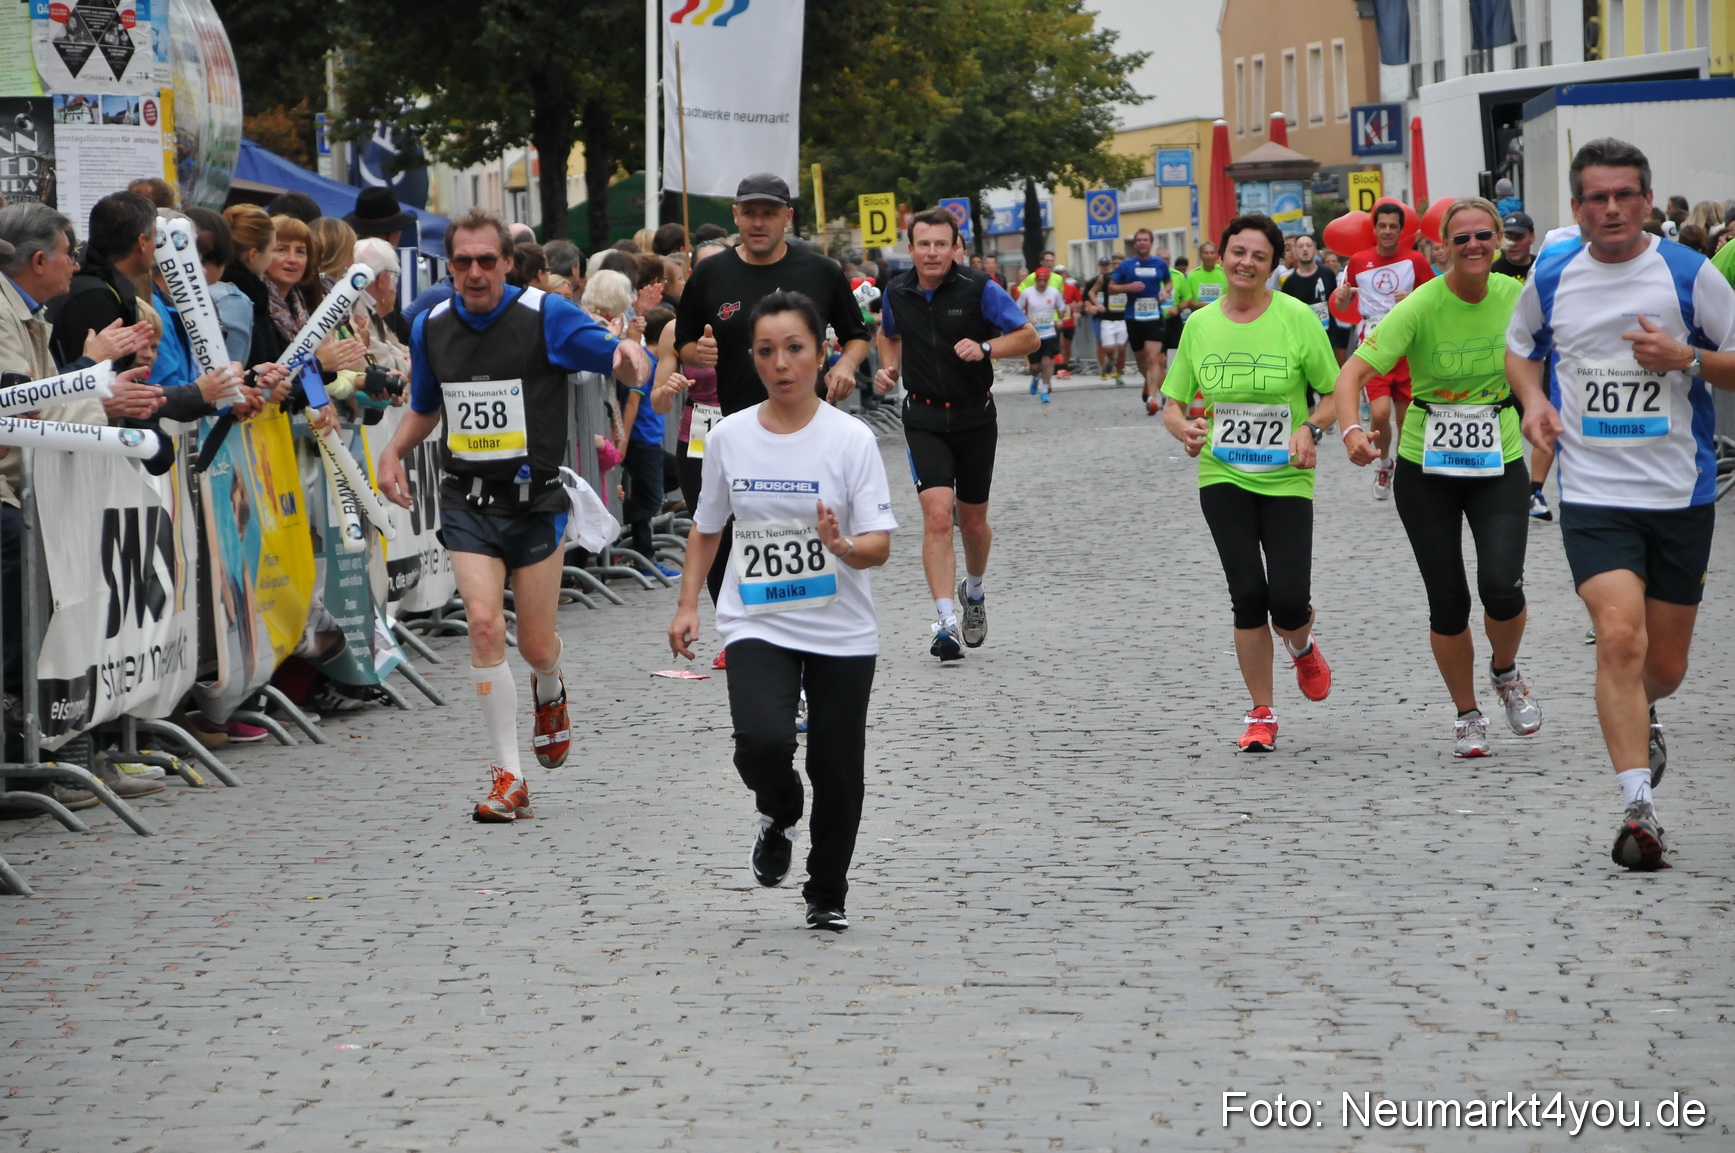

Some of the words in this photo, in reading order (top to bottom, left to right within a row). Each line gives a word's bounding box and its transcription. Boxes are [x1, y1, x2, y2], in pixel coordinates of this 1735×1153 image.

[733, 111, 790, 124] neumarkt
[1353, 174, 1381, 185] Block
[863, 195, 891, 207] Block
[1359, 188, 1376, 213] D
[869, 210, 887, 235] D
[1090, 224, 1118, 236] TAXI
[160, 257, 192, 304] BMW
[317, 294, 352, 335] BMW
[1199, 352, 1289, 390] OPF
[1577, 367, 1606, 377] PARTL
[444, 390, 467, 398] PARTL
[468, 388, 508, 397] Neumarkt
[1585, 380, 1662, 413] 2672
[457, 400, 508, 430] 258
[1215, 408, 1241, 416] PARTL
[1242, 409, 1278, 418] Neumarkt
[1453, 411, 1489, 419] Neumarkt
[1220, 418, 1284, 446] 2372
[1598, 420, 1646, 435] Thomas
[1432, 421, 1495, 449] 2383
[467, 437, 501, 449] Lothar
[1228, 451, 1273, 463] Christine
[1441, 453, 1486, 466] Theresia
[735, 530, 764, 539] PARTL
[765, 526, 812, 538] Neumarkt
[743, 538, 826, 578] 2638
[765, 584, 807, 600] Maika
